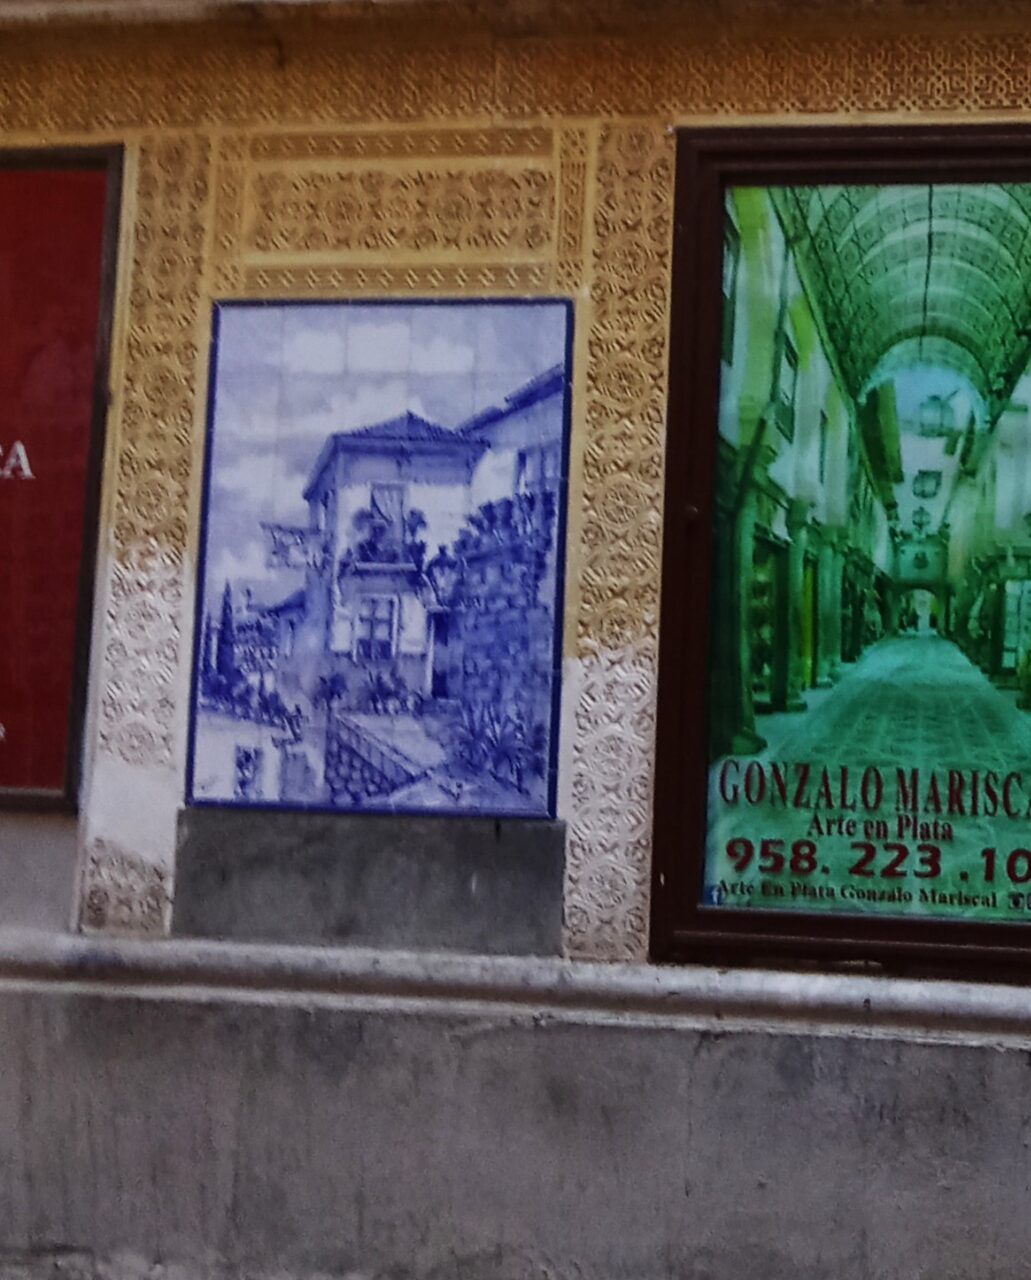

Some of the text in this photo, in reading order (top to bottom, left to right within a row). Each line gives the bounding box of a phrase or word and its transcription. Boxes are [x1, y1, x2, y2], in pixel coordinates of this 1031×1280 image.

[0, 439, 36, 480] A
[718, 758, 884, 812] GONZALO
[807, 811, 953, 842] Arte en Plata
[848, 841, 942, 880] 223
[718, 878, 754, 897] Arte
[840, 883, 913, 904] Gonzalo
[919, 888, 998, 909] Mariscal
